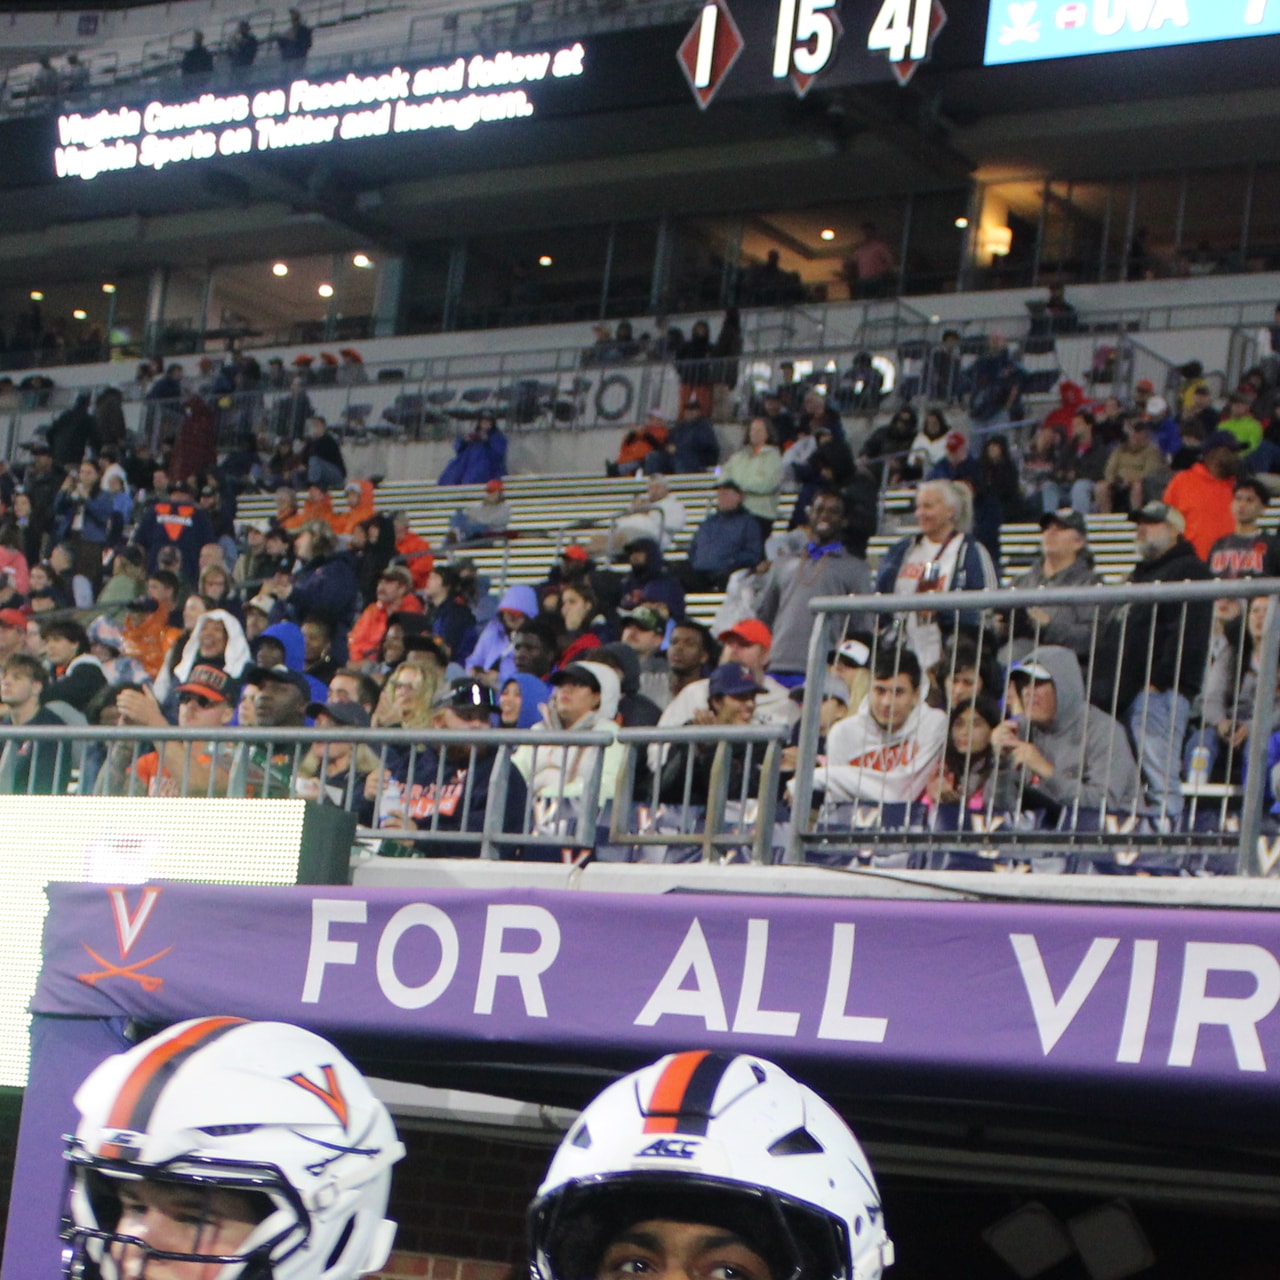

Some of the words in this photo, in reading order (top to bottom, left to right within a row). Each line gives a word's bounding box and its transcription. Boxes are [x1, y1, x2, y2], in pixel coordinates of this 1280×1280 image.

[58, 107, 141, 147] Virginia
[144, 94, 249, 133] Cavaliers
[252, 90, 285, 117] on
[289, 67, 410, 113] Facebook
[413, 59, 465, 96] and
[468, 52, 550, 88] follow
[552, 43, 585, 77] at
[55, 139, 137, 180] Virginia
[140, 130, 216, 170] Sports
[219, 127, 252, 155] on
[255, 114, 338, 150] Twitter
[340, 102, 391, 140] and
[301, 899, 561, 1018] FOR
[634, 916, 889, 1043] ALL
[635, 1137, 702, 1159] ACC
